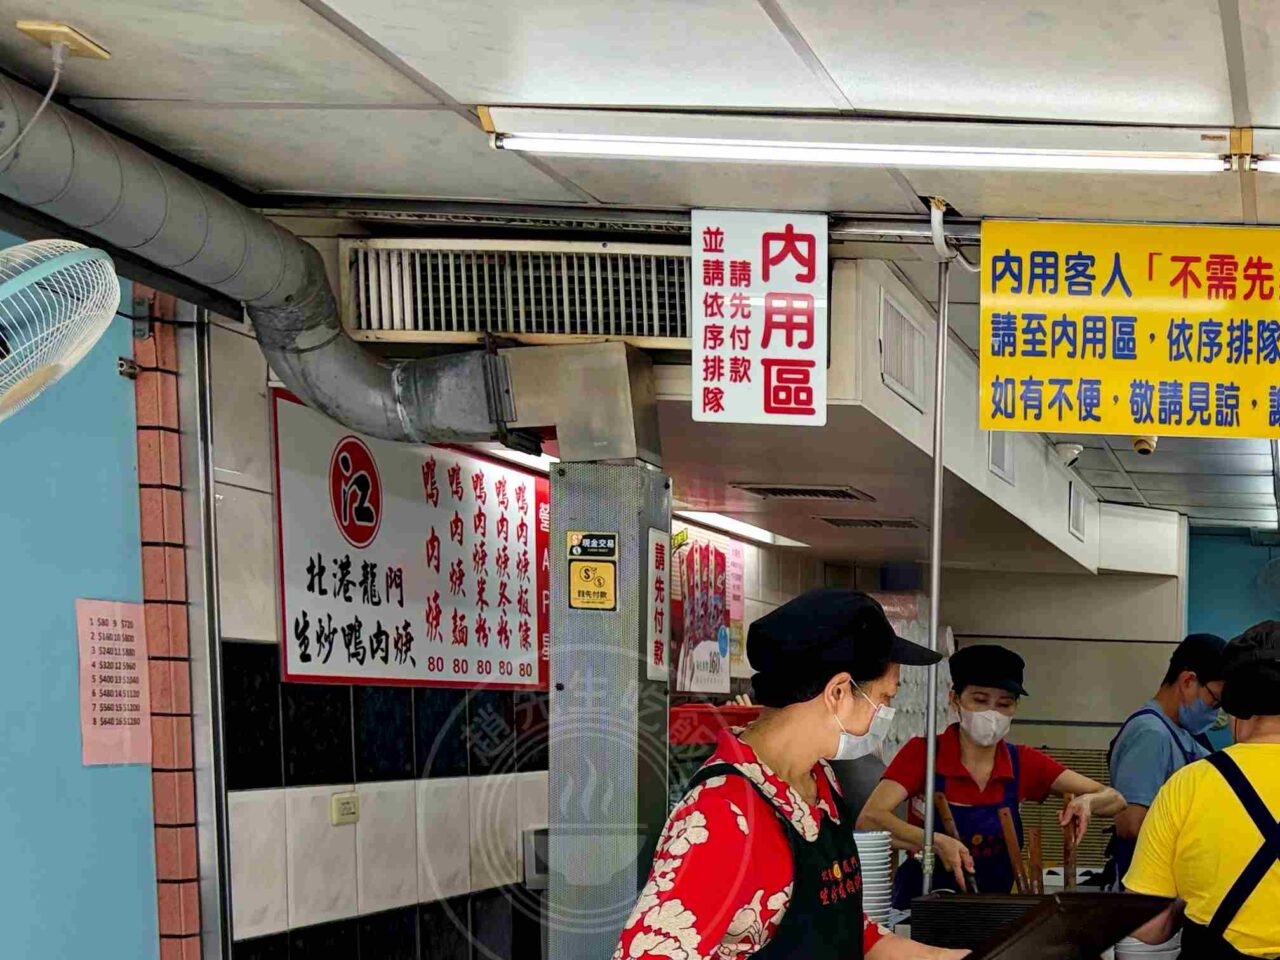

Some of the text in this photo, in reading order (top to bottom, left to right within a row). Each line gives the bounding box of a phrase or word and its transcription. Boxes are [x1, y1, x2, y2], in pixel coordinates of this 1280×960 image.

[702, 226, 725, 414] 並請依序排隊
[729, 260, 752, 383] 請先付款
[760, 223, 816, 416] 內用區
[582, 538, 615, 548] 現金交易
[306, 552, 404, 608] 北港龍門
[654, 543, 665, 666] 請先付款
[427, 656, 444, 673] 80
[453, 658, 468, 675] 80
[477, 660, 492, 675] 80
[499, 661, 513, 676] 80
[519, 662, 532, 678] 80
